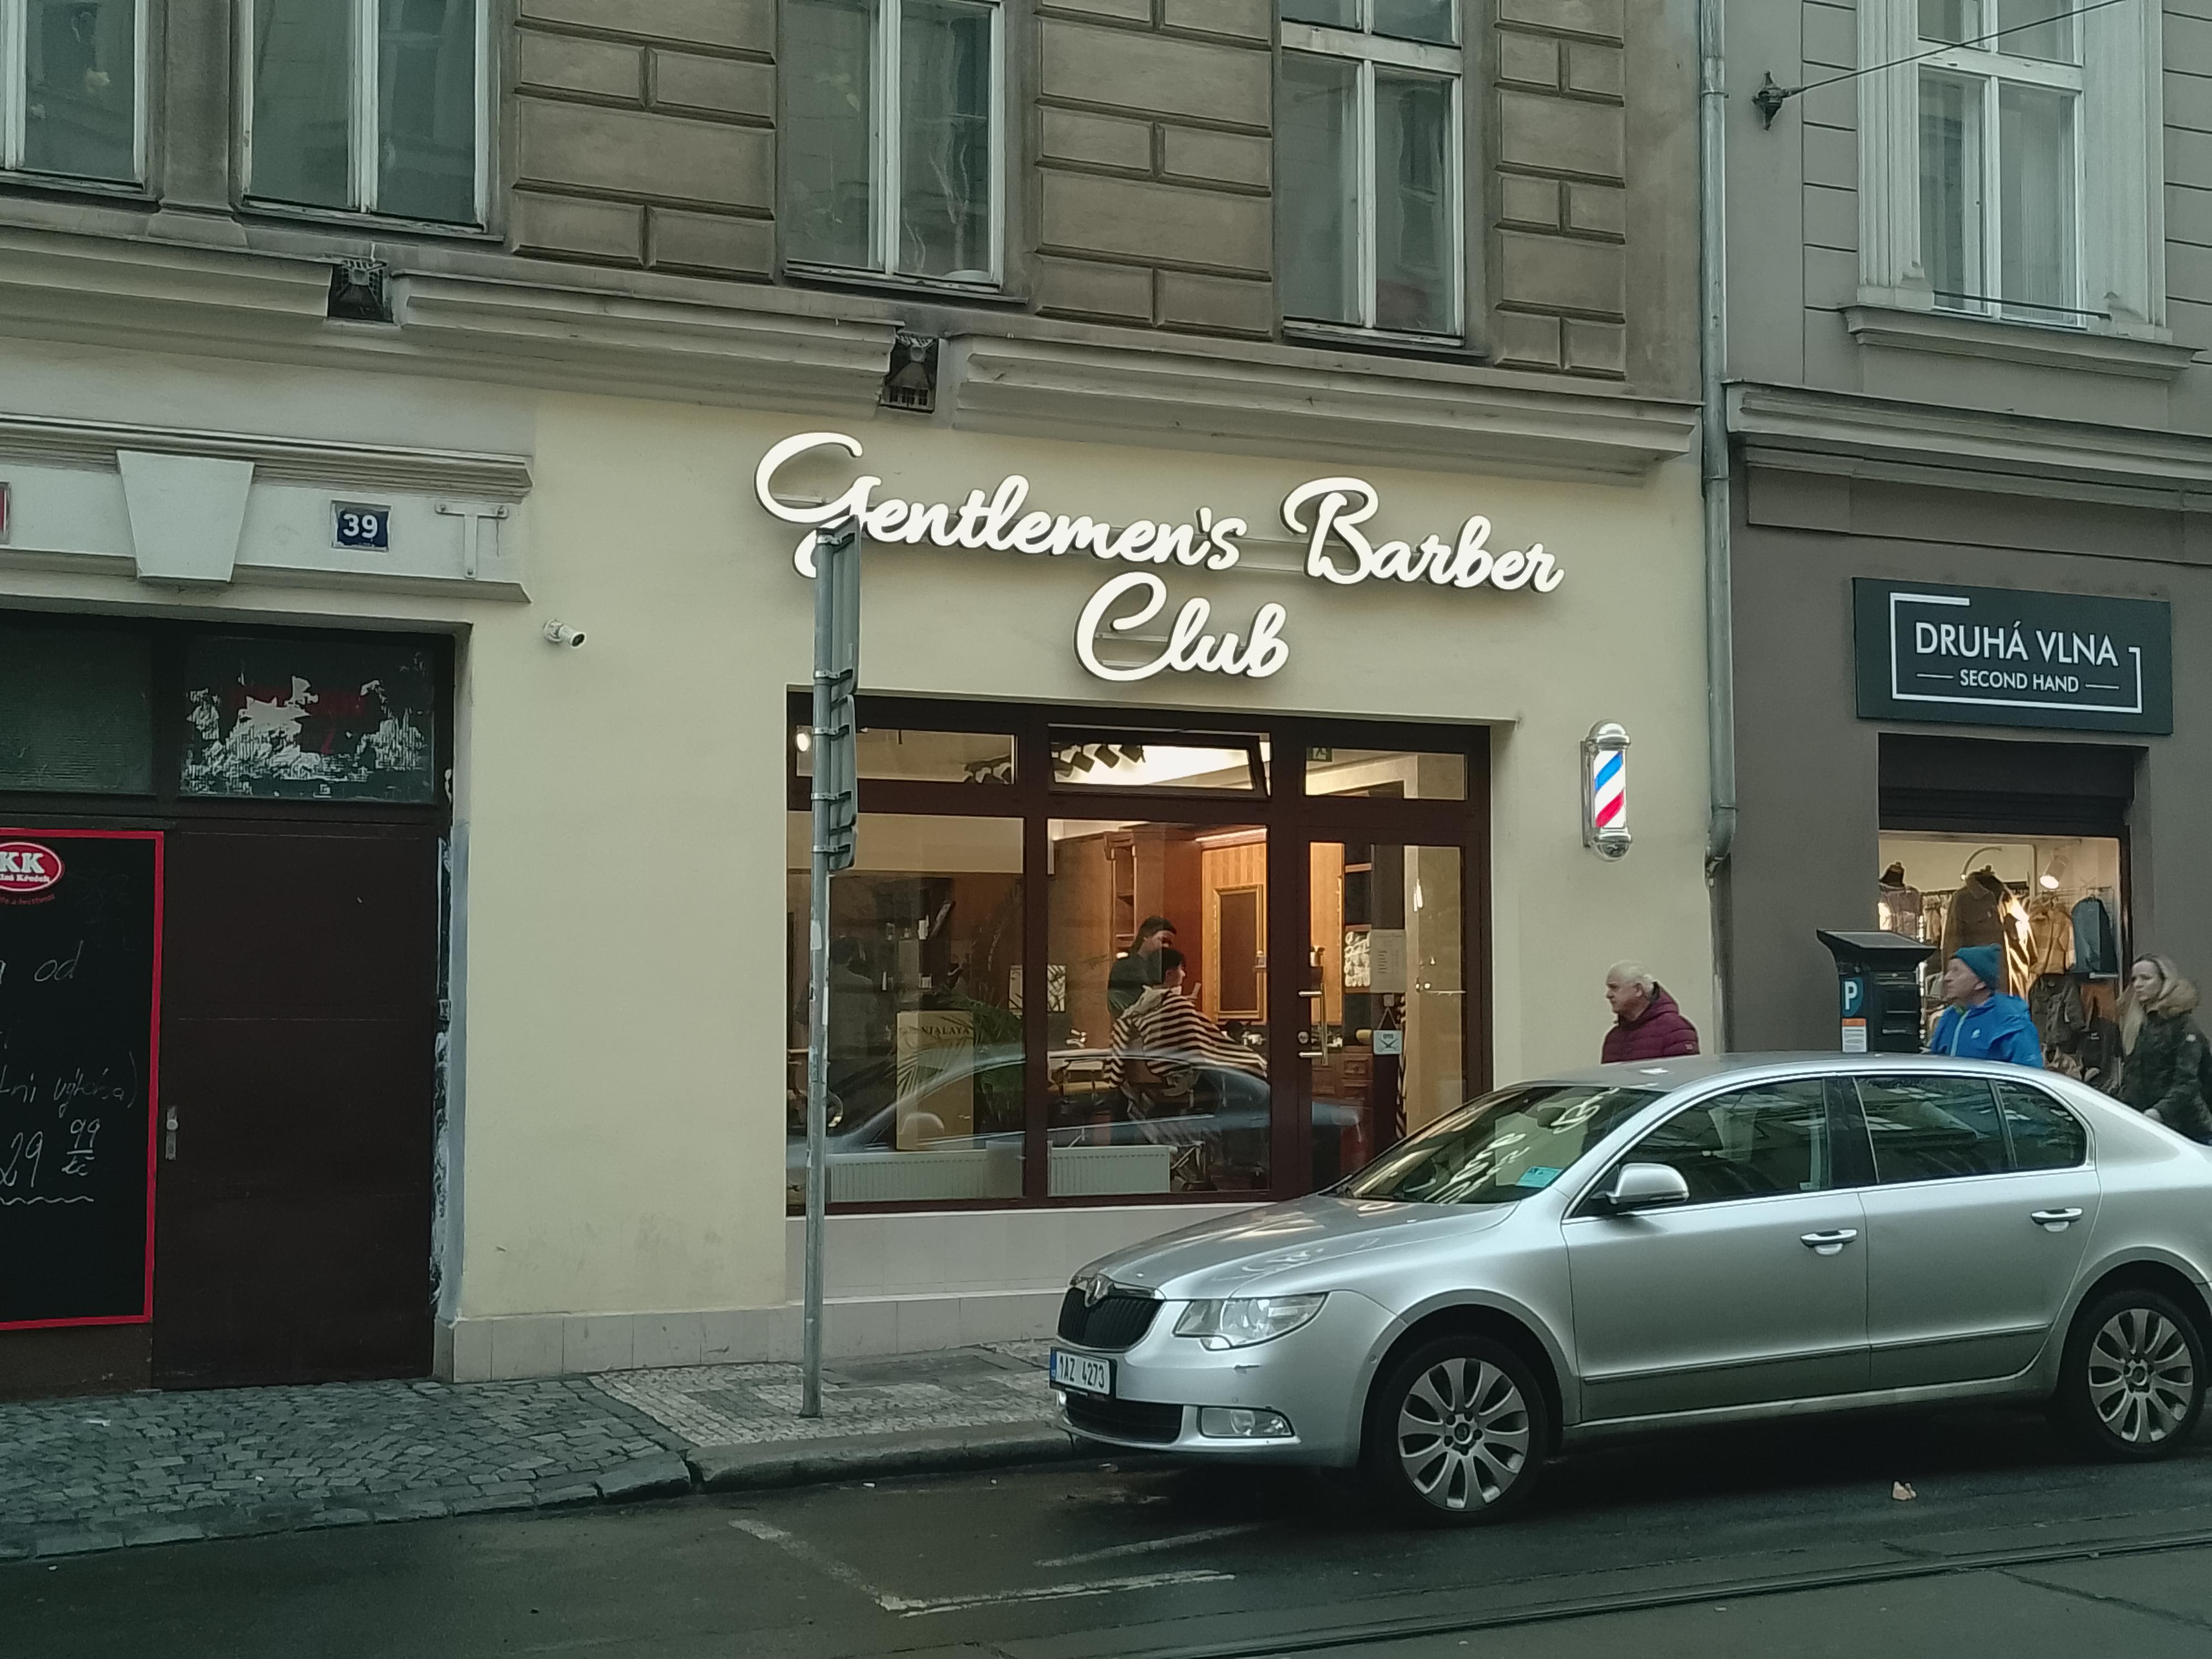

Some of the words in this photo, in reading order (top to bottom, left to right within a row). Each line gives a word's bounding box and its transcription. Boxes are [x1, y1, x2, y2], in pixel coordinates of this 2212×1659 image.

[343, 513, 378, 539] 39
[754, 431, 1248, 578] Gentlemen's
[1280, 476, 1564, 593] Barber
[1075, 571, 1290, 682] Club
[1915, 620, 2029, 661] DRUHÁ
[2035, 629, 2119, 667] VLNA
[1960, 669, 2028, 690] SECOND
[2032, 673, 2079, 692] HAND
[34, 940, 84, 982] od
[1844, 981, 1858, 1010] P
[70, 1118, 101, 1149] 99
[1060, 1355, 1075, 1382] 1AZ
[1082, 1361, 1104, 1389] 4273
